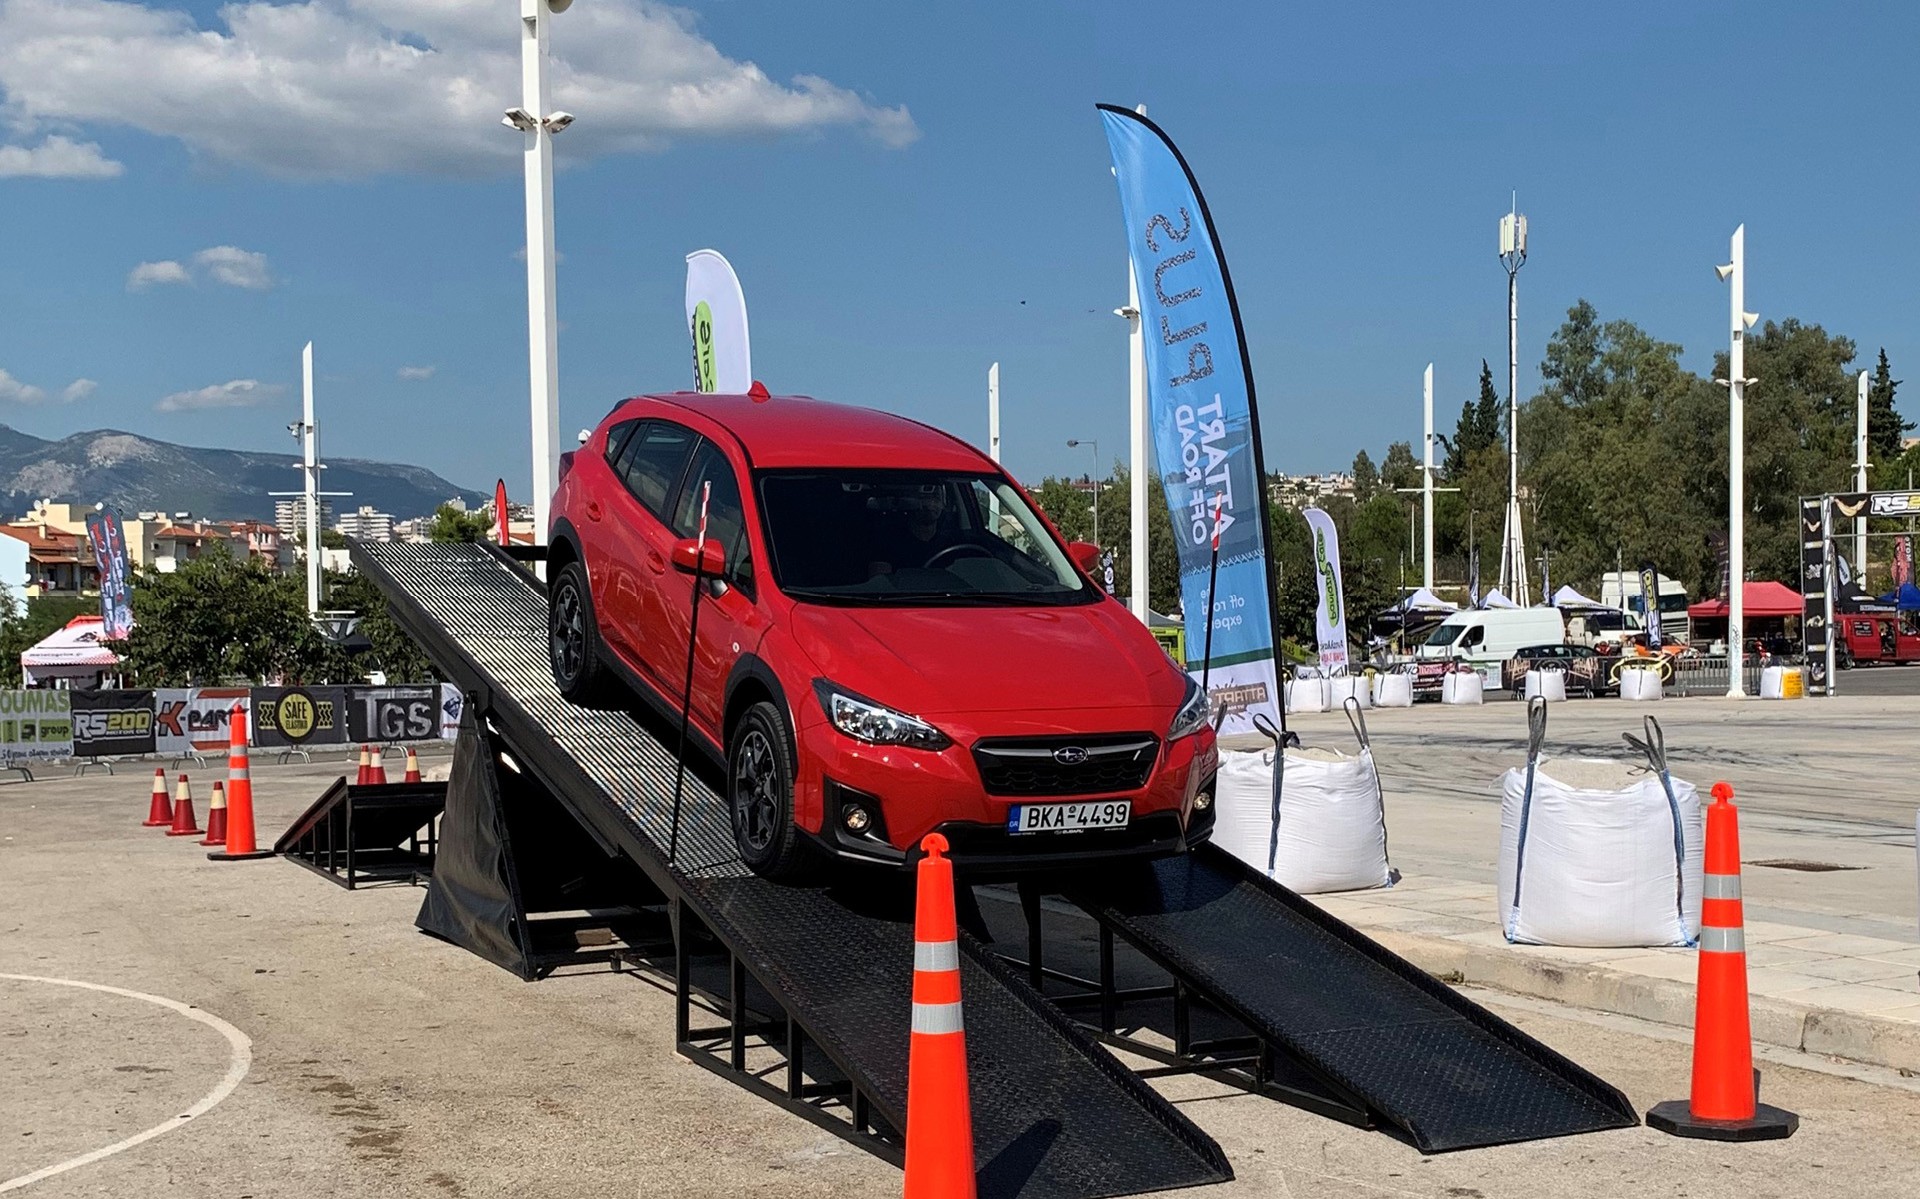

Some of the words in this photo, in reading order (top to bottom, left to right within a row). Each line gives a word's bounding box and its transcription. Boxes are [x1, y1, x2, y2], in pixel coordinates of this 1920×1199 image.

[285, 701, 308, 719] SAFE
[41, 724, 69, 738] group
[74, 712, 150, 738] RS200
